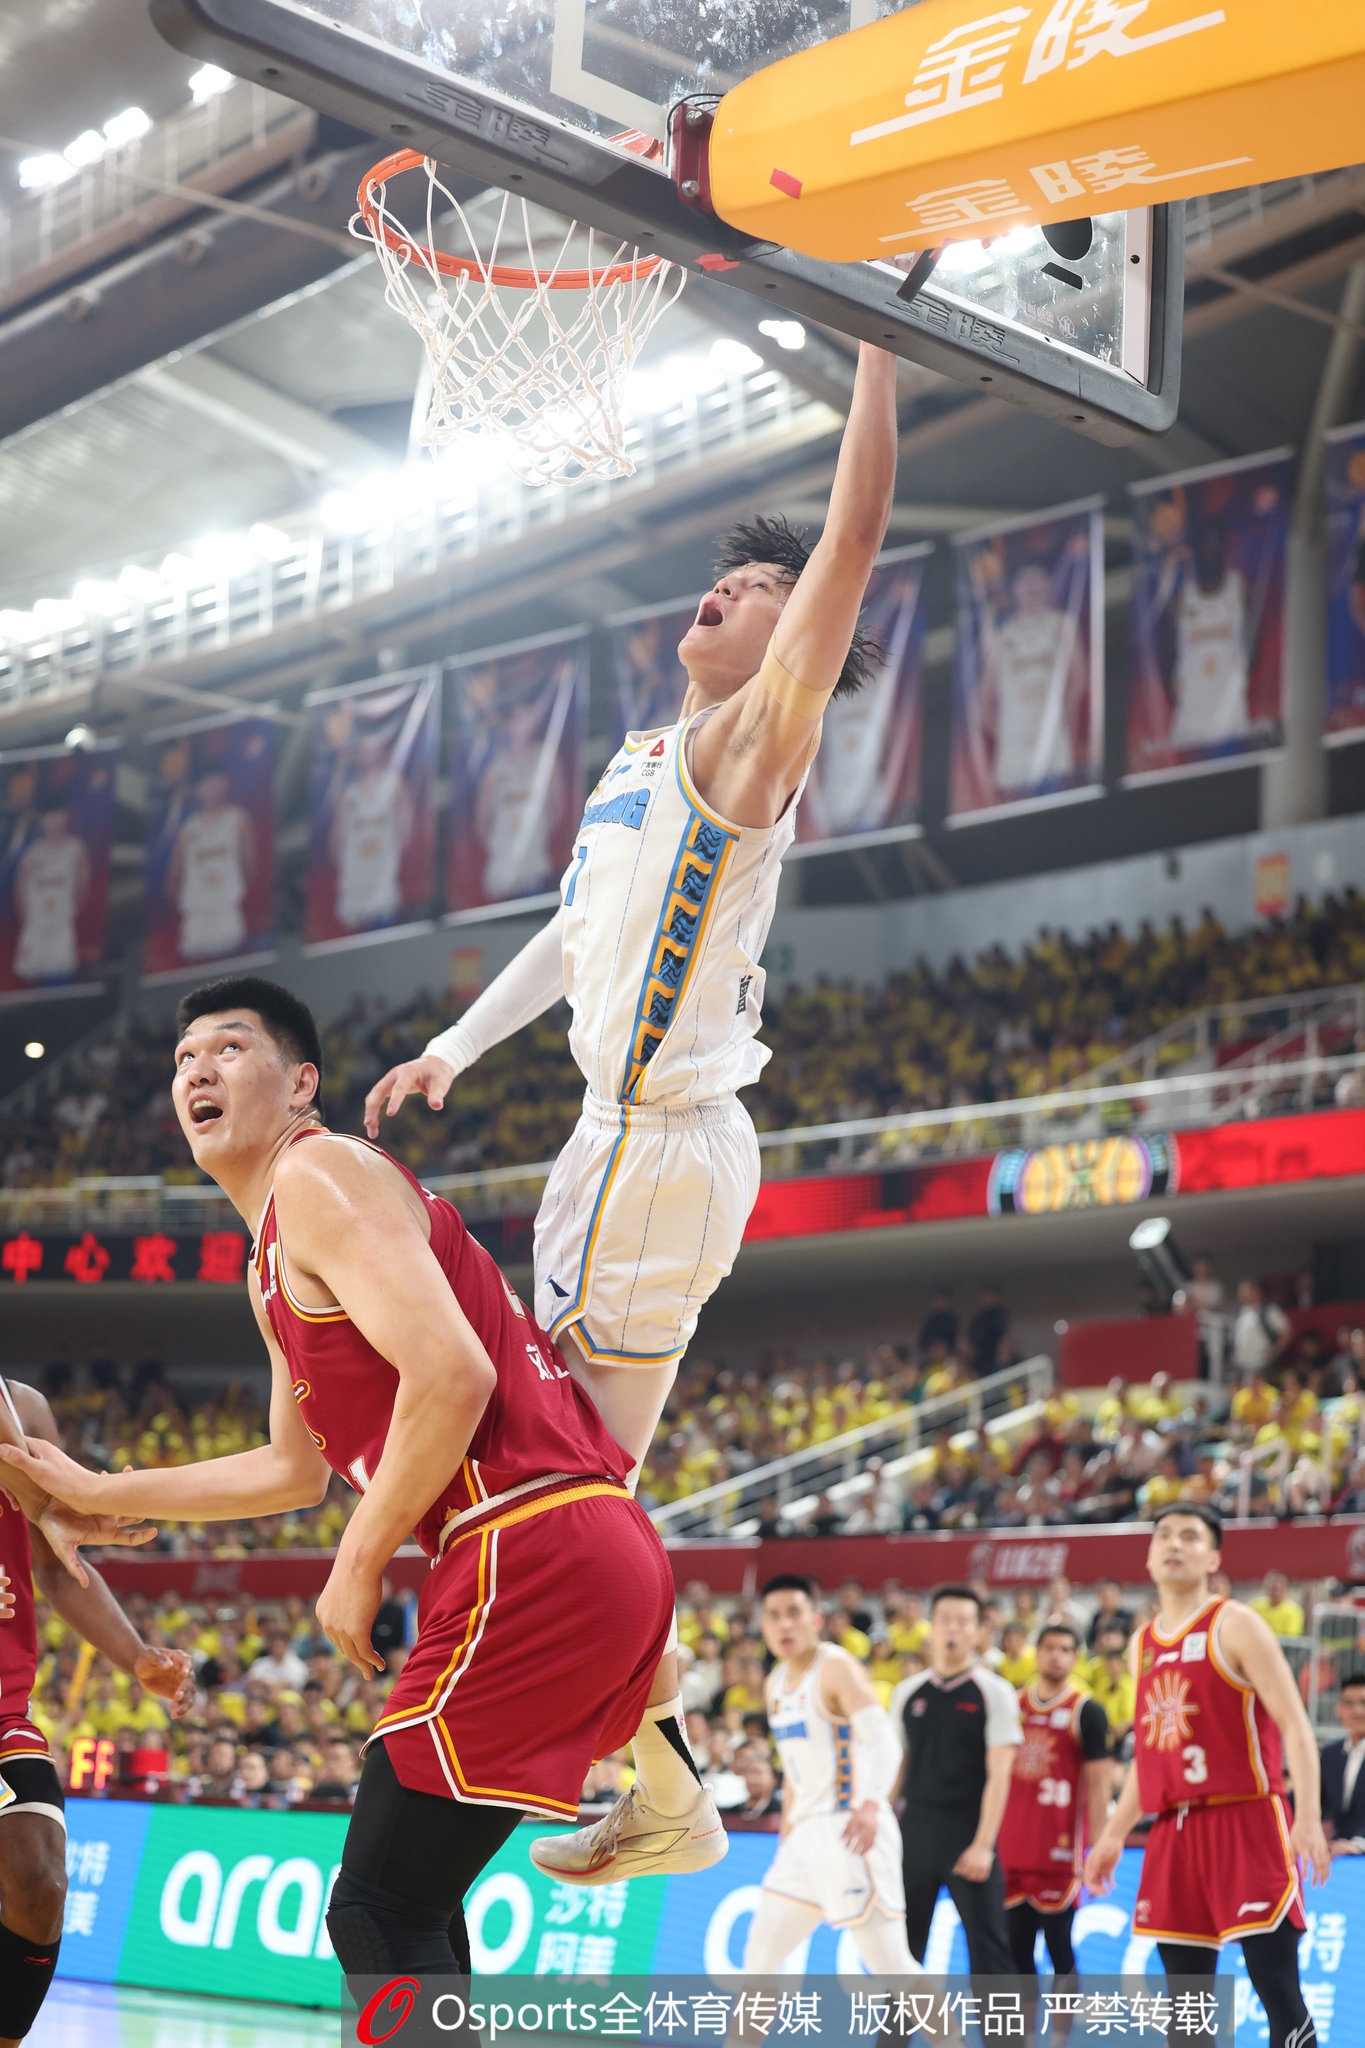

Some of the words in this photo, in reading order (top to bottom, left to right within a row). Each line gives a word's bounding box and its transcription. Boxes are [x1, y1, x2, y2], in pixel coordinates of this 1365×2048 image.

[850, 0, 1225, 146] 金陵
[878, 144, 1256, 243] 金陵
[641, 769, 656, 777] CGB
[1182, 1745, 1208, 1784] 3
[160, 1850, 534, 1975] arao
